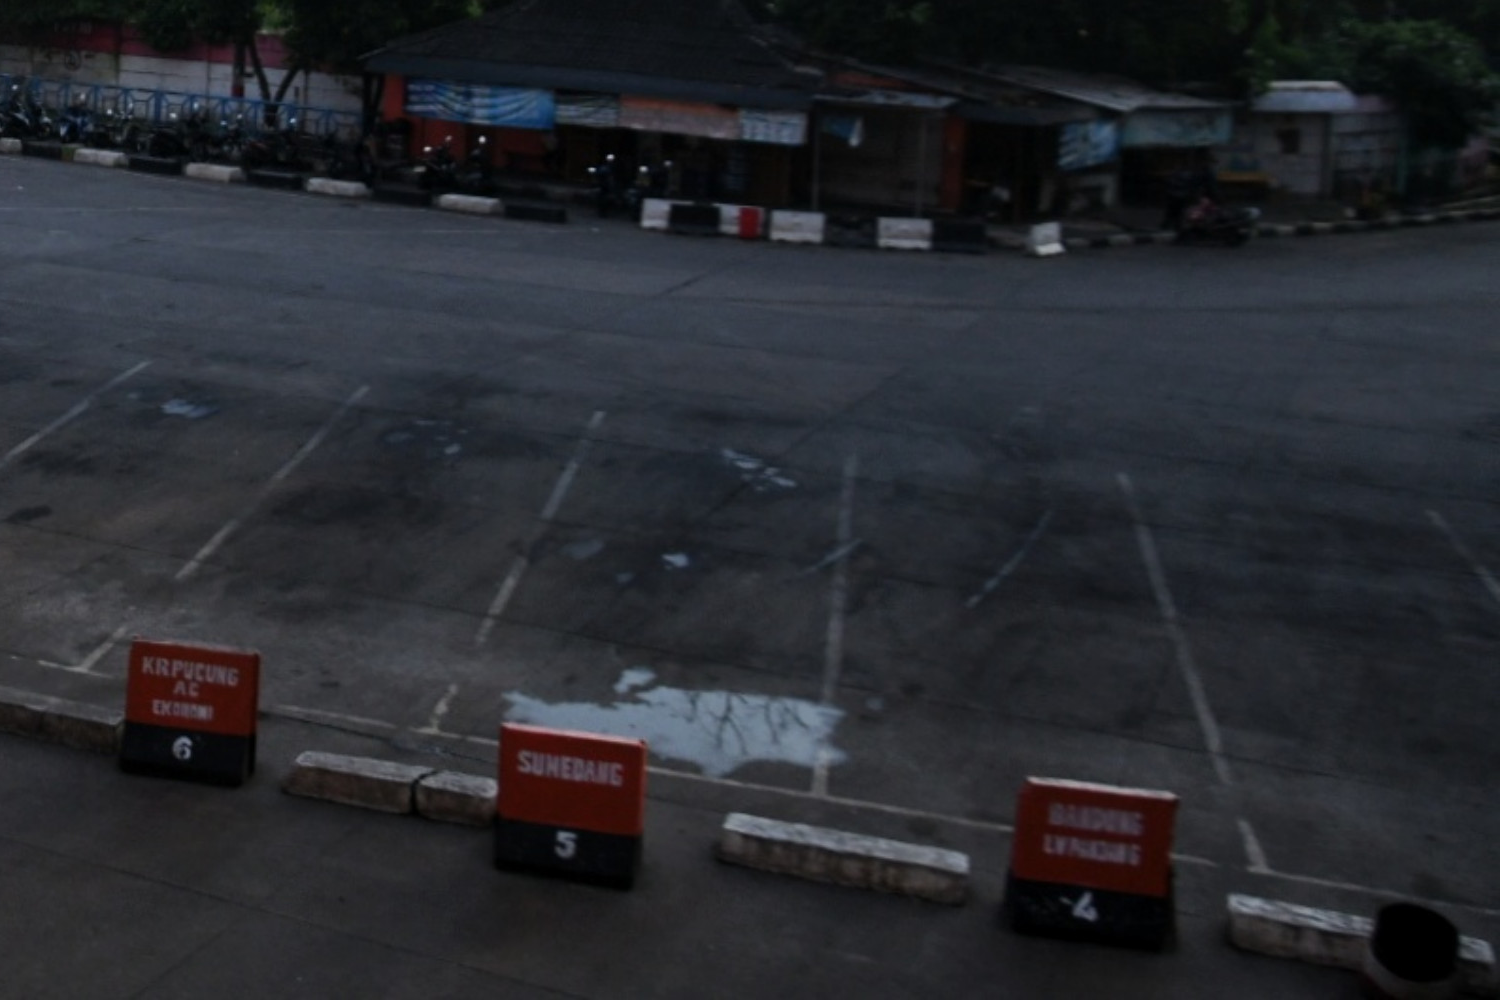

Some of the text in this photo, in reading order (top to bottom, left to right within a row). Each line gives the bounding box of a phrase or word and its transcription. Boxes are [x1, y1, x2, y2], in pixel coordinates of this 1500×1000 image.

[173, 680, 200, 698] AC
[171, 735, 194, 761] 6
[516, 750, 624, 788] SUMEDANG
[553, 829, 579, 860] 5
[1066, 889, 1099, 923] 4
